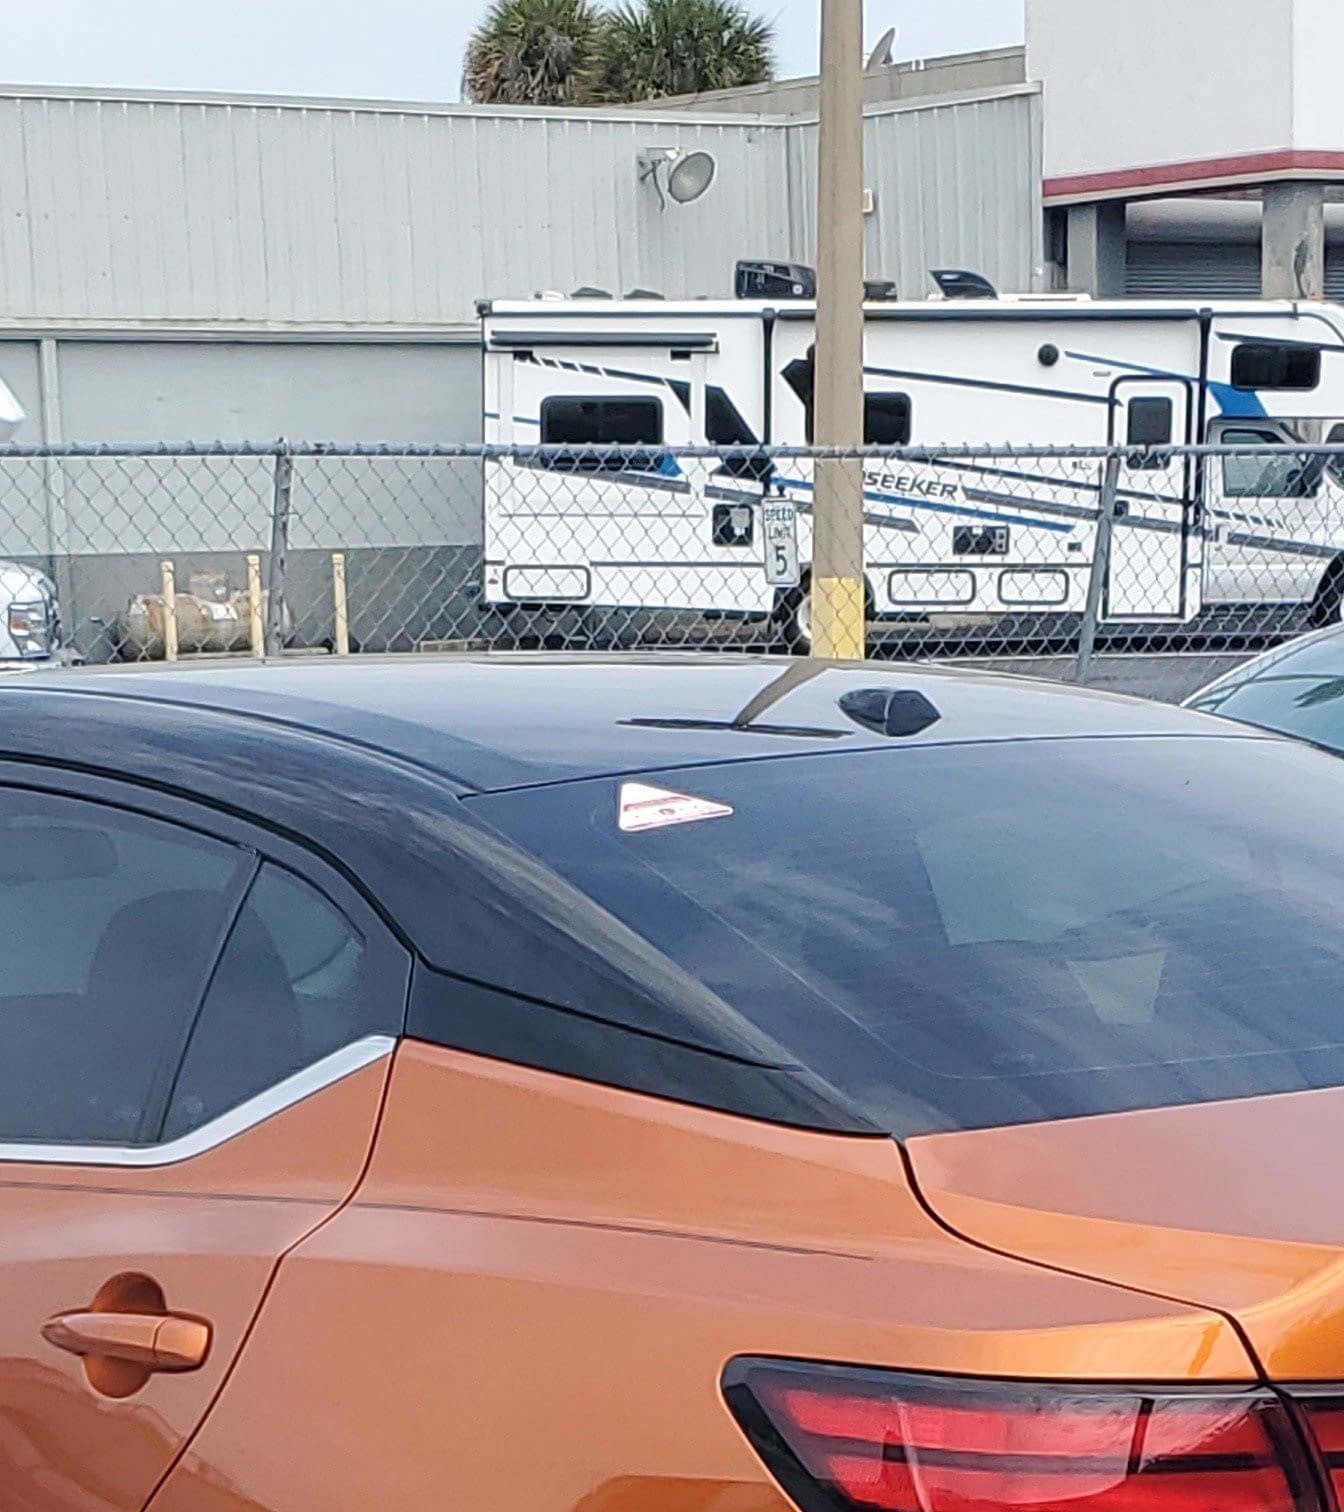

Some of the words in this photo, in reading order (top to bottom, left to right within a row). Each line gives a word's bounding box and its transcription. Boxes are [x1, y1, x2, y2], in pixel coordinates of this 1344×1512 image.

[863, 471, 958, 500] SEEKER
[765, 507, 794, 522] SPEED
[775, 545, 788, 576] 5
